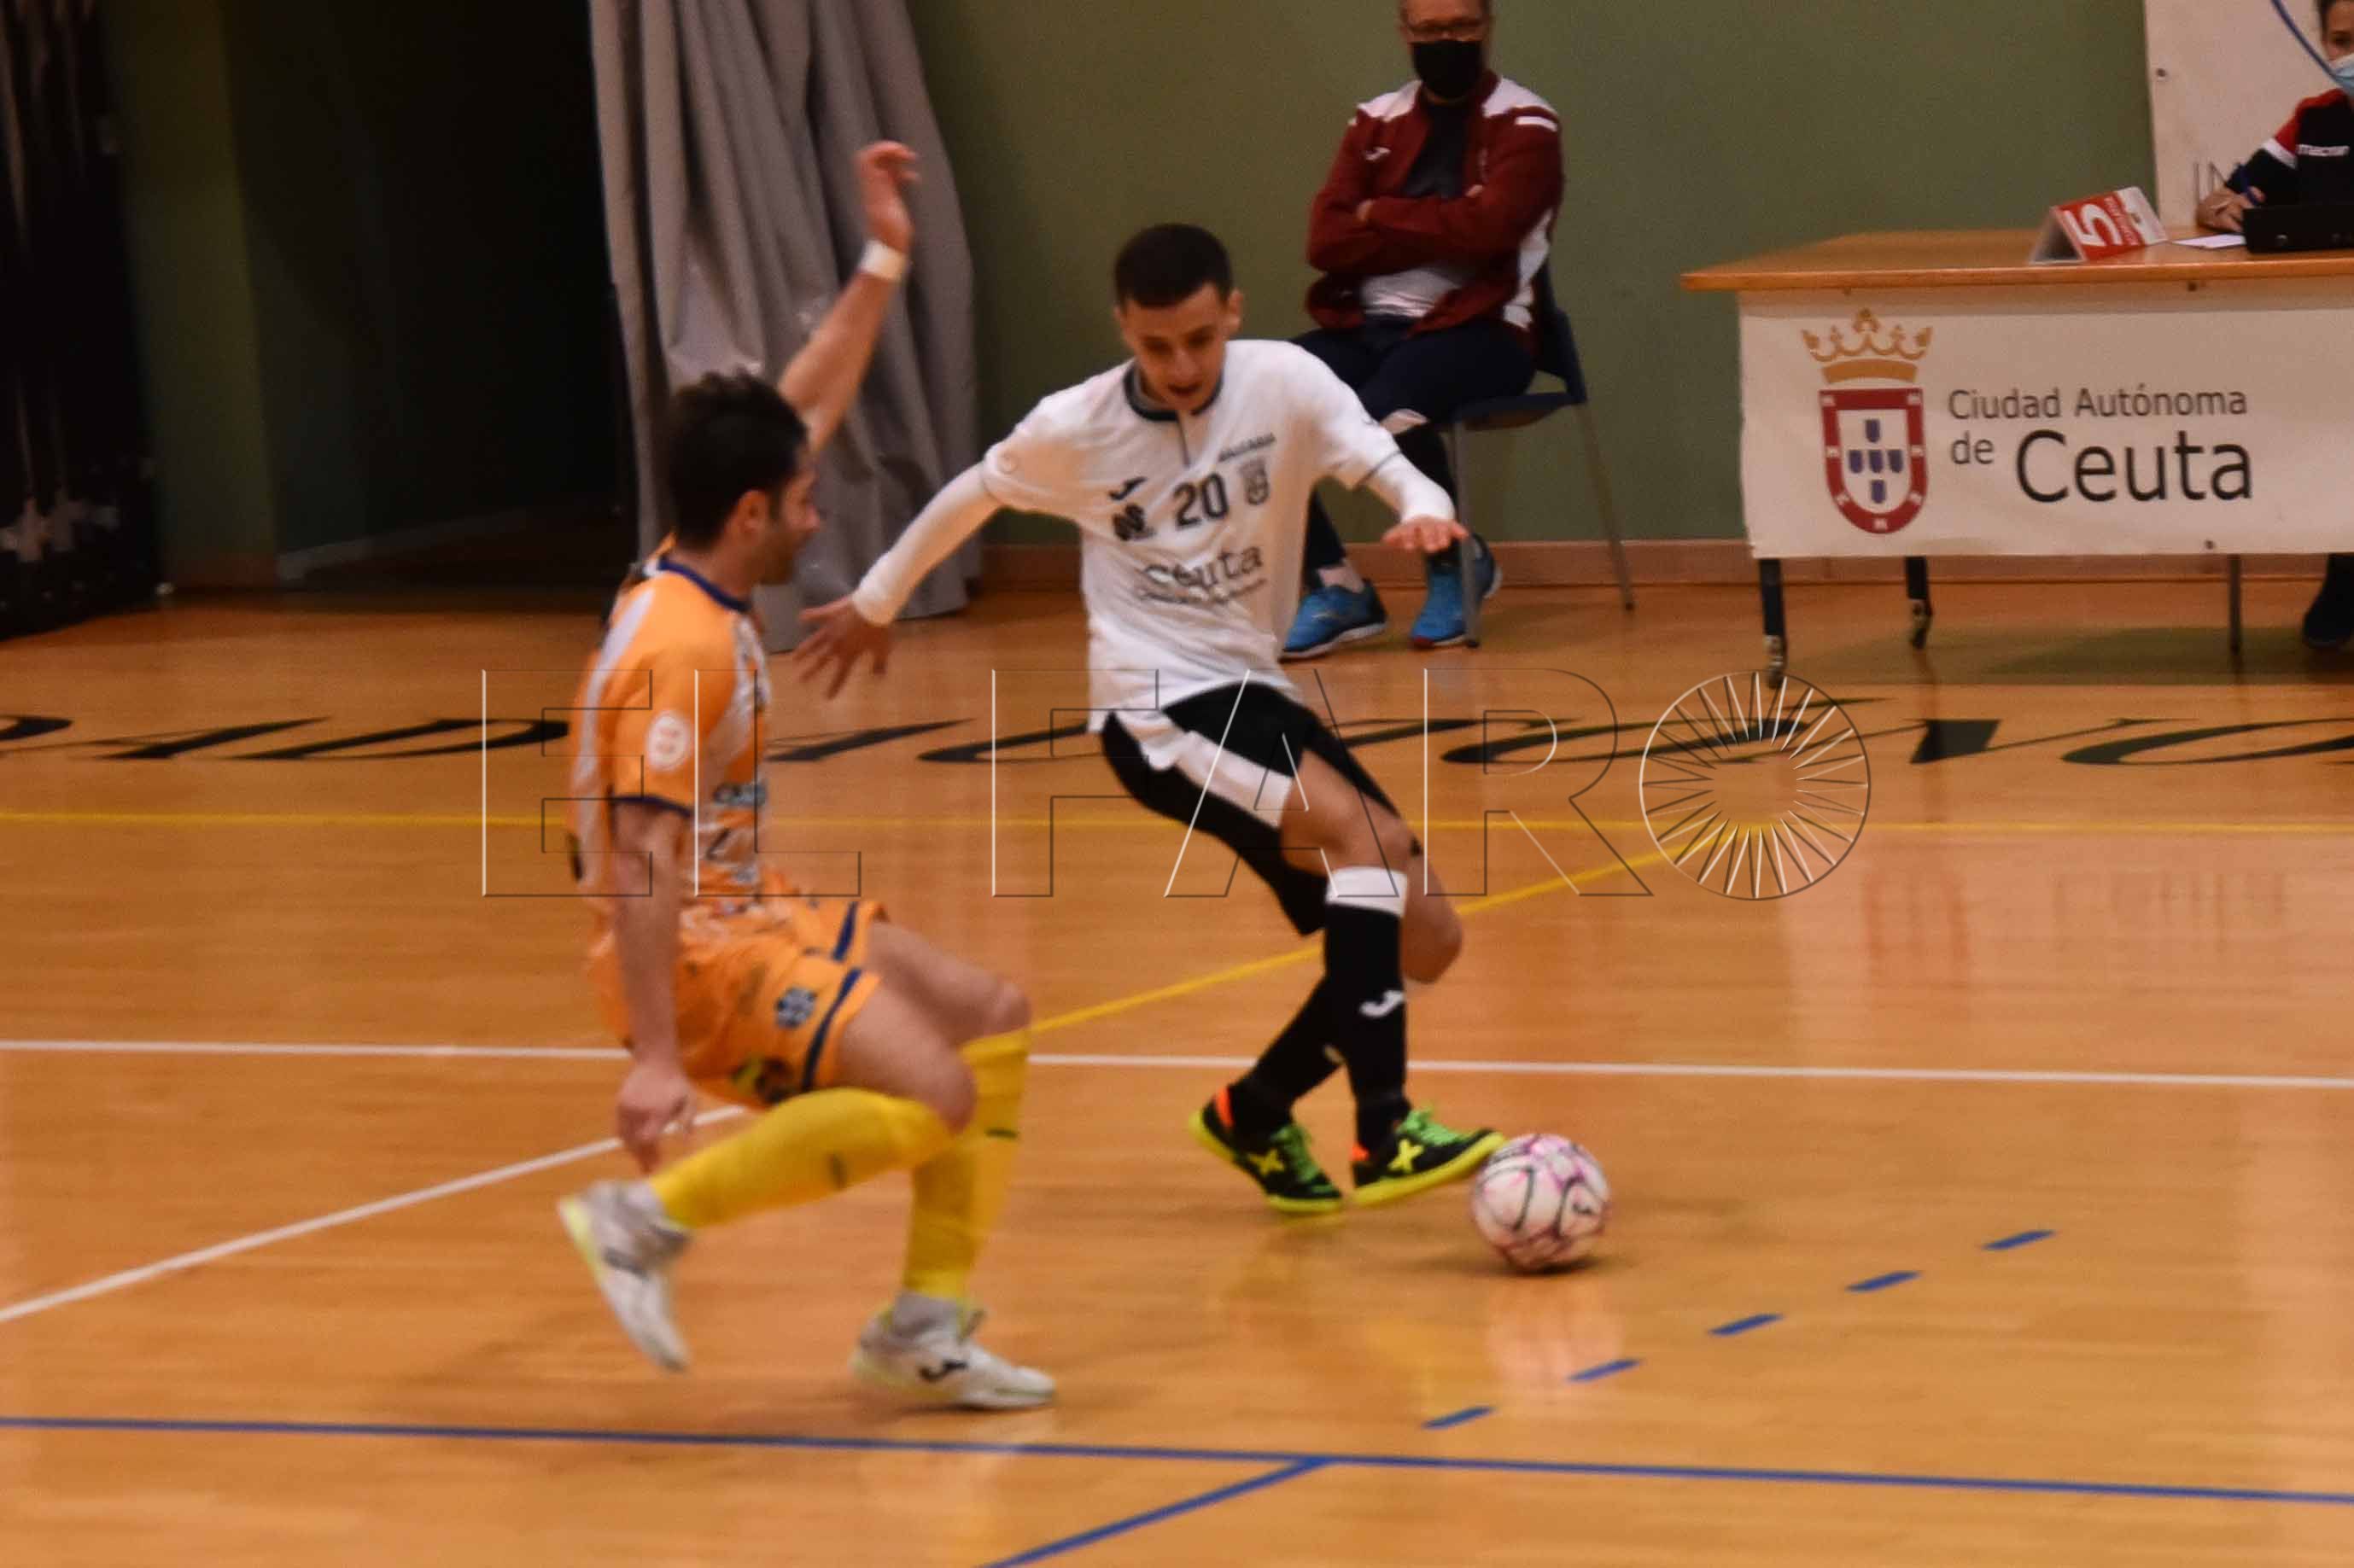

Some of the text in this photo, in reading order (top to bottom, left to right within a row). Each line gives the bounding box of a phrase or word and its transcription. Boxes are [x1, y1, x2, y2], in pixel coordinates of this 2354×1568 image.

[1948, 384, 2248, 419] Ciudad Autónoma
[1950, 428, 2252, 503] de Ceuta
[1172, 472, 1230, 528] 20
